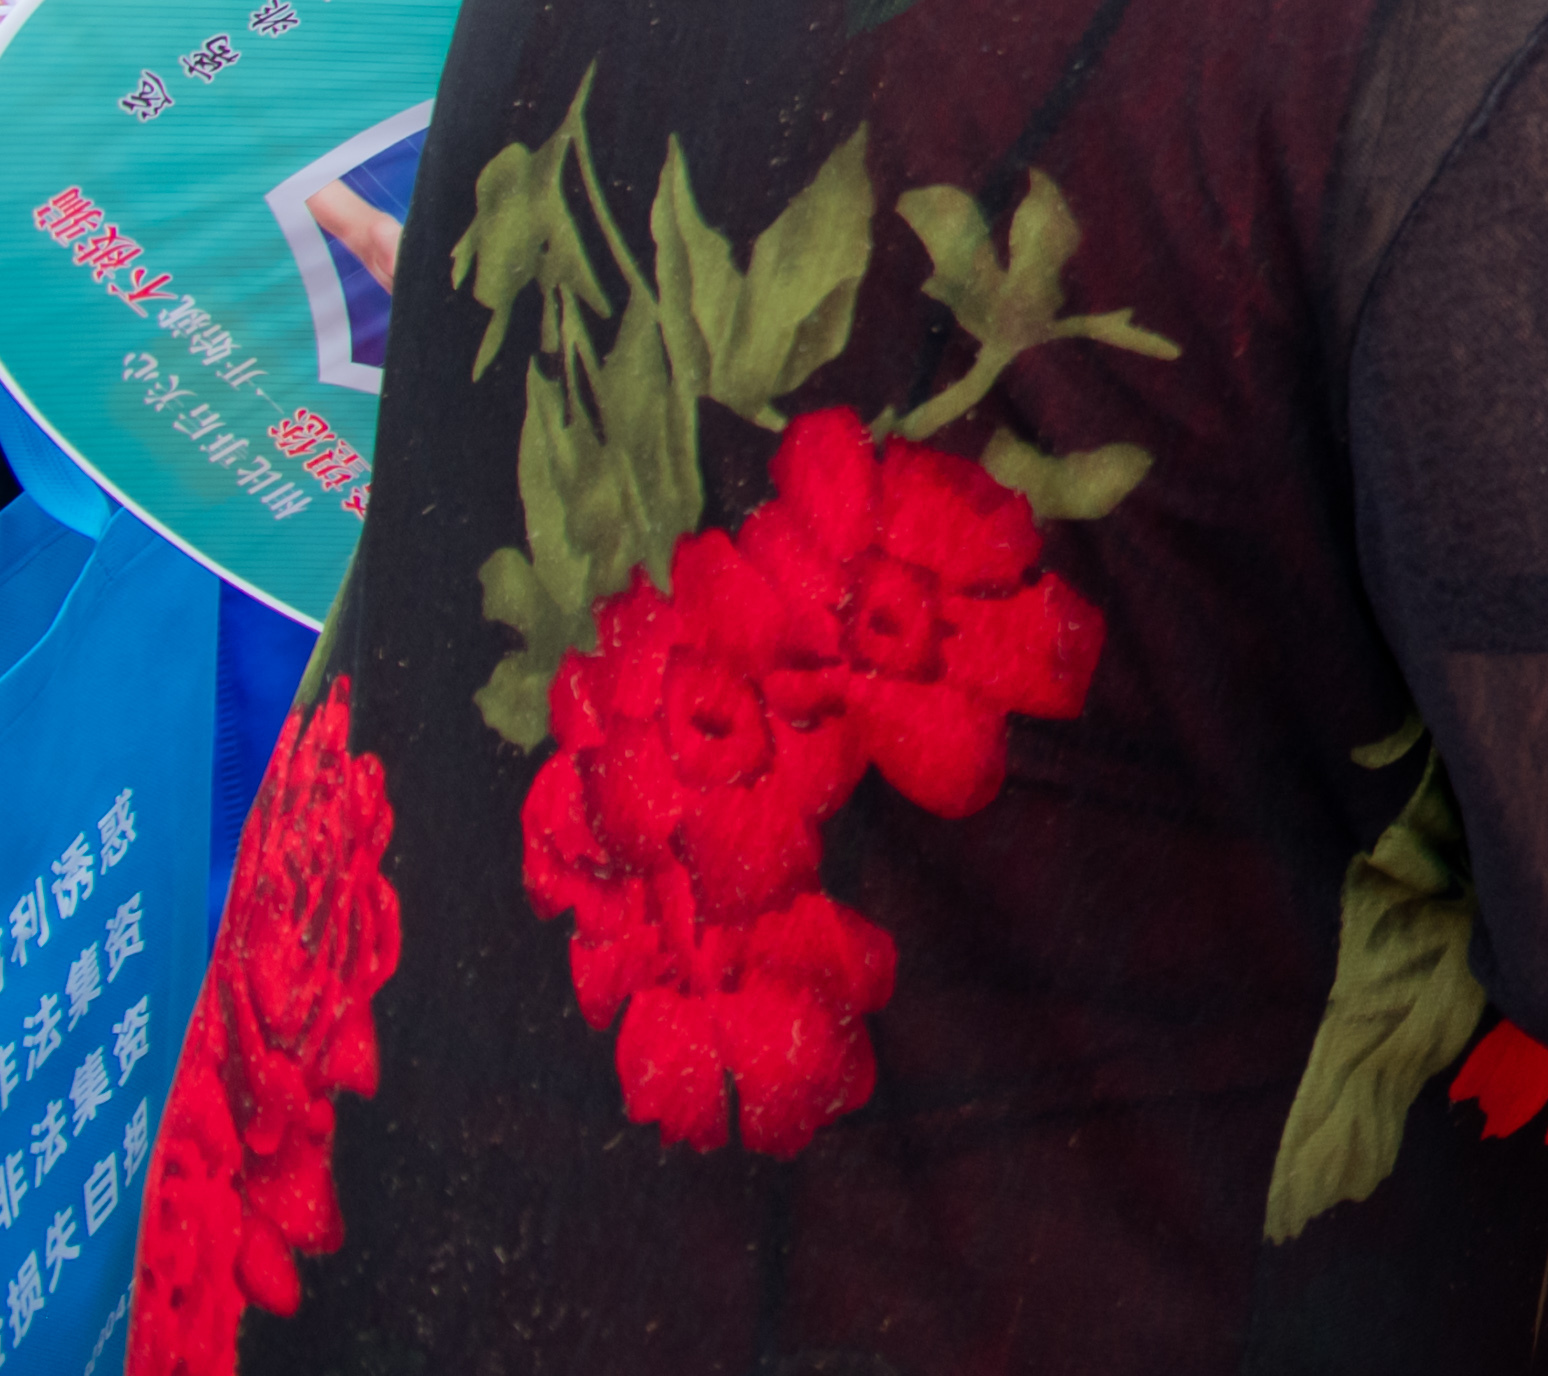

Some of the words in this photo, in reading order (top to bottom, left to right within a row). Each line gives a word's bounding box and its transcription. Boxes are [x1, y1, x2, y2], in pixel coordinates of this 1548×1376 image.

[0, 786, 137, 993] 利诱惑
[0, 1095, 149, 1368] 损失自担
